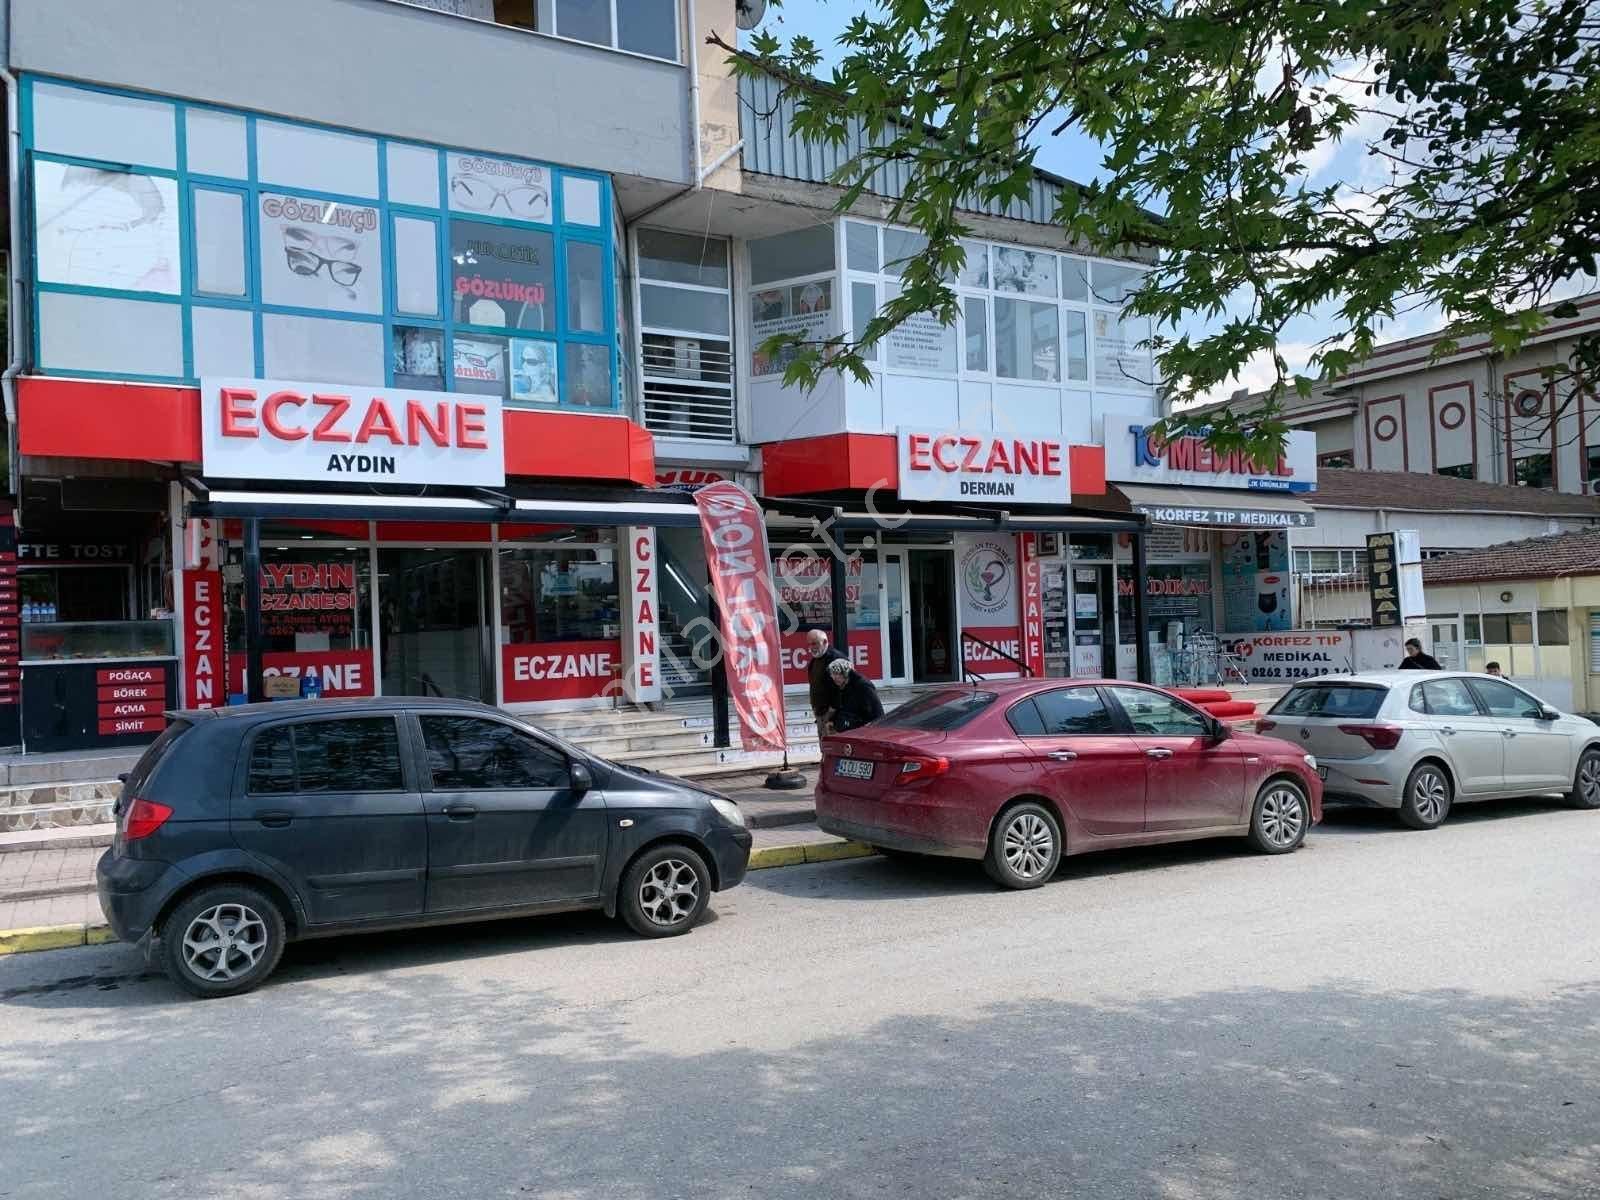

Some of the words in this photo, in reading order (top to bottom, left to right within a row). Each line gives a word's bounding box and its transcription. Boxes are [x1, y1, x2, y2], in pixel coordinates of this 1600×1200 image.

[456, 273, 545, 308] GÖZLÜKÇÜ
[220, 387, 489, 450] ECZANE
[909, 432, 1062, 477] ECZANE
[326, 453, 396, 474] AYDIN
[960, 481, 1015, 496] DERMAN
[1214, 511, 1236, 524] TIP
[70, 543, 127, 558] TOST
[774, 557, 865, 578] DERMN
[1118, 576, 1211, 595] MDİKAL
[634, 527, 656, 687] CZANE
[1026, 543, 1040, 657] ECZANE
[1316, 635, 1342, 647] TIP
[963, 639, 1020, 662] ECZANE
[1264, 650, 1332, 662] MEDİKAL
[513, 652, 612, 681] ECZANE
[1252, 667, 1282, 678] 0262
[109, 671, 152, 682] POĞAÇA
[113, 688, 147, 698] BÖREK
[114, 704, 145, 715] AÇMA
[115, 720, 144, 732] SİMİT
